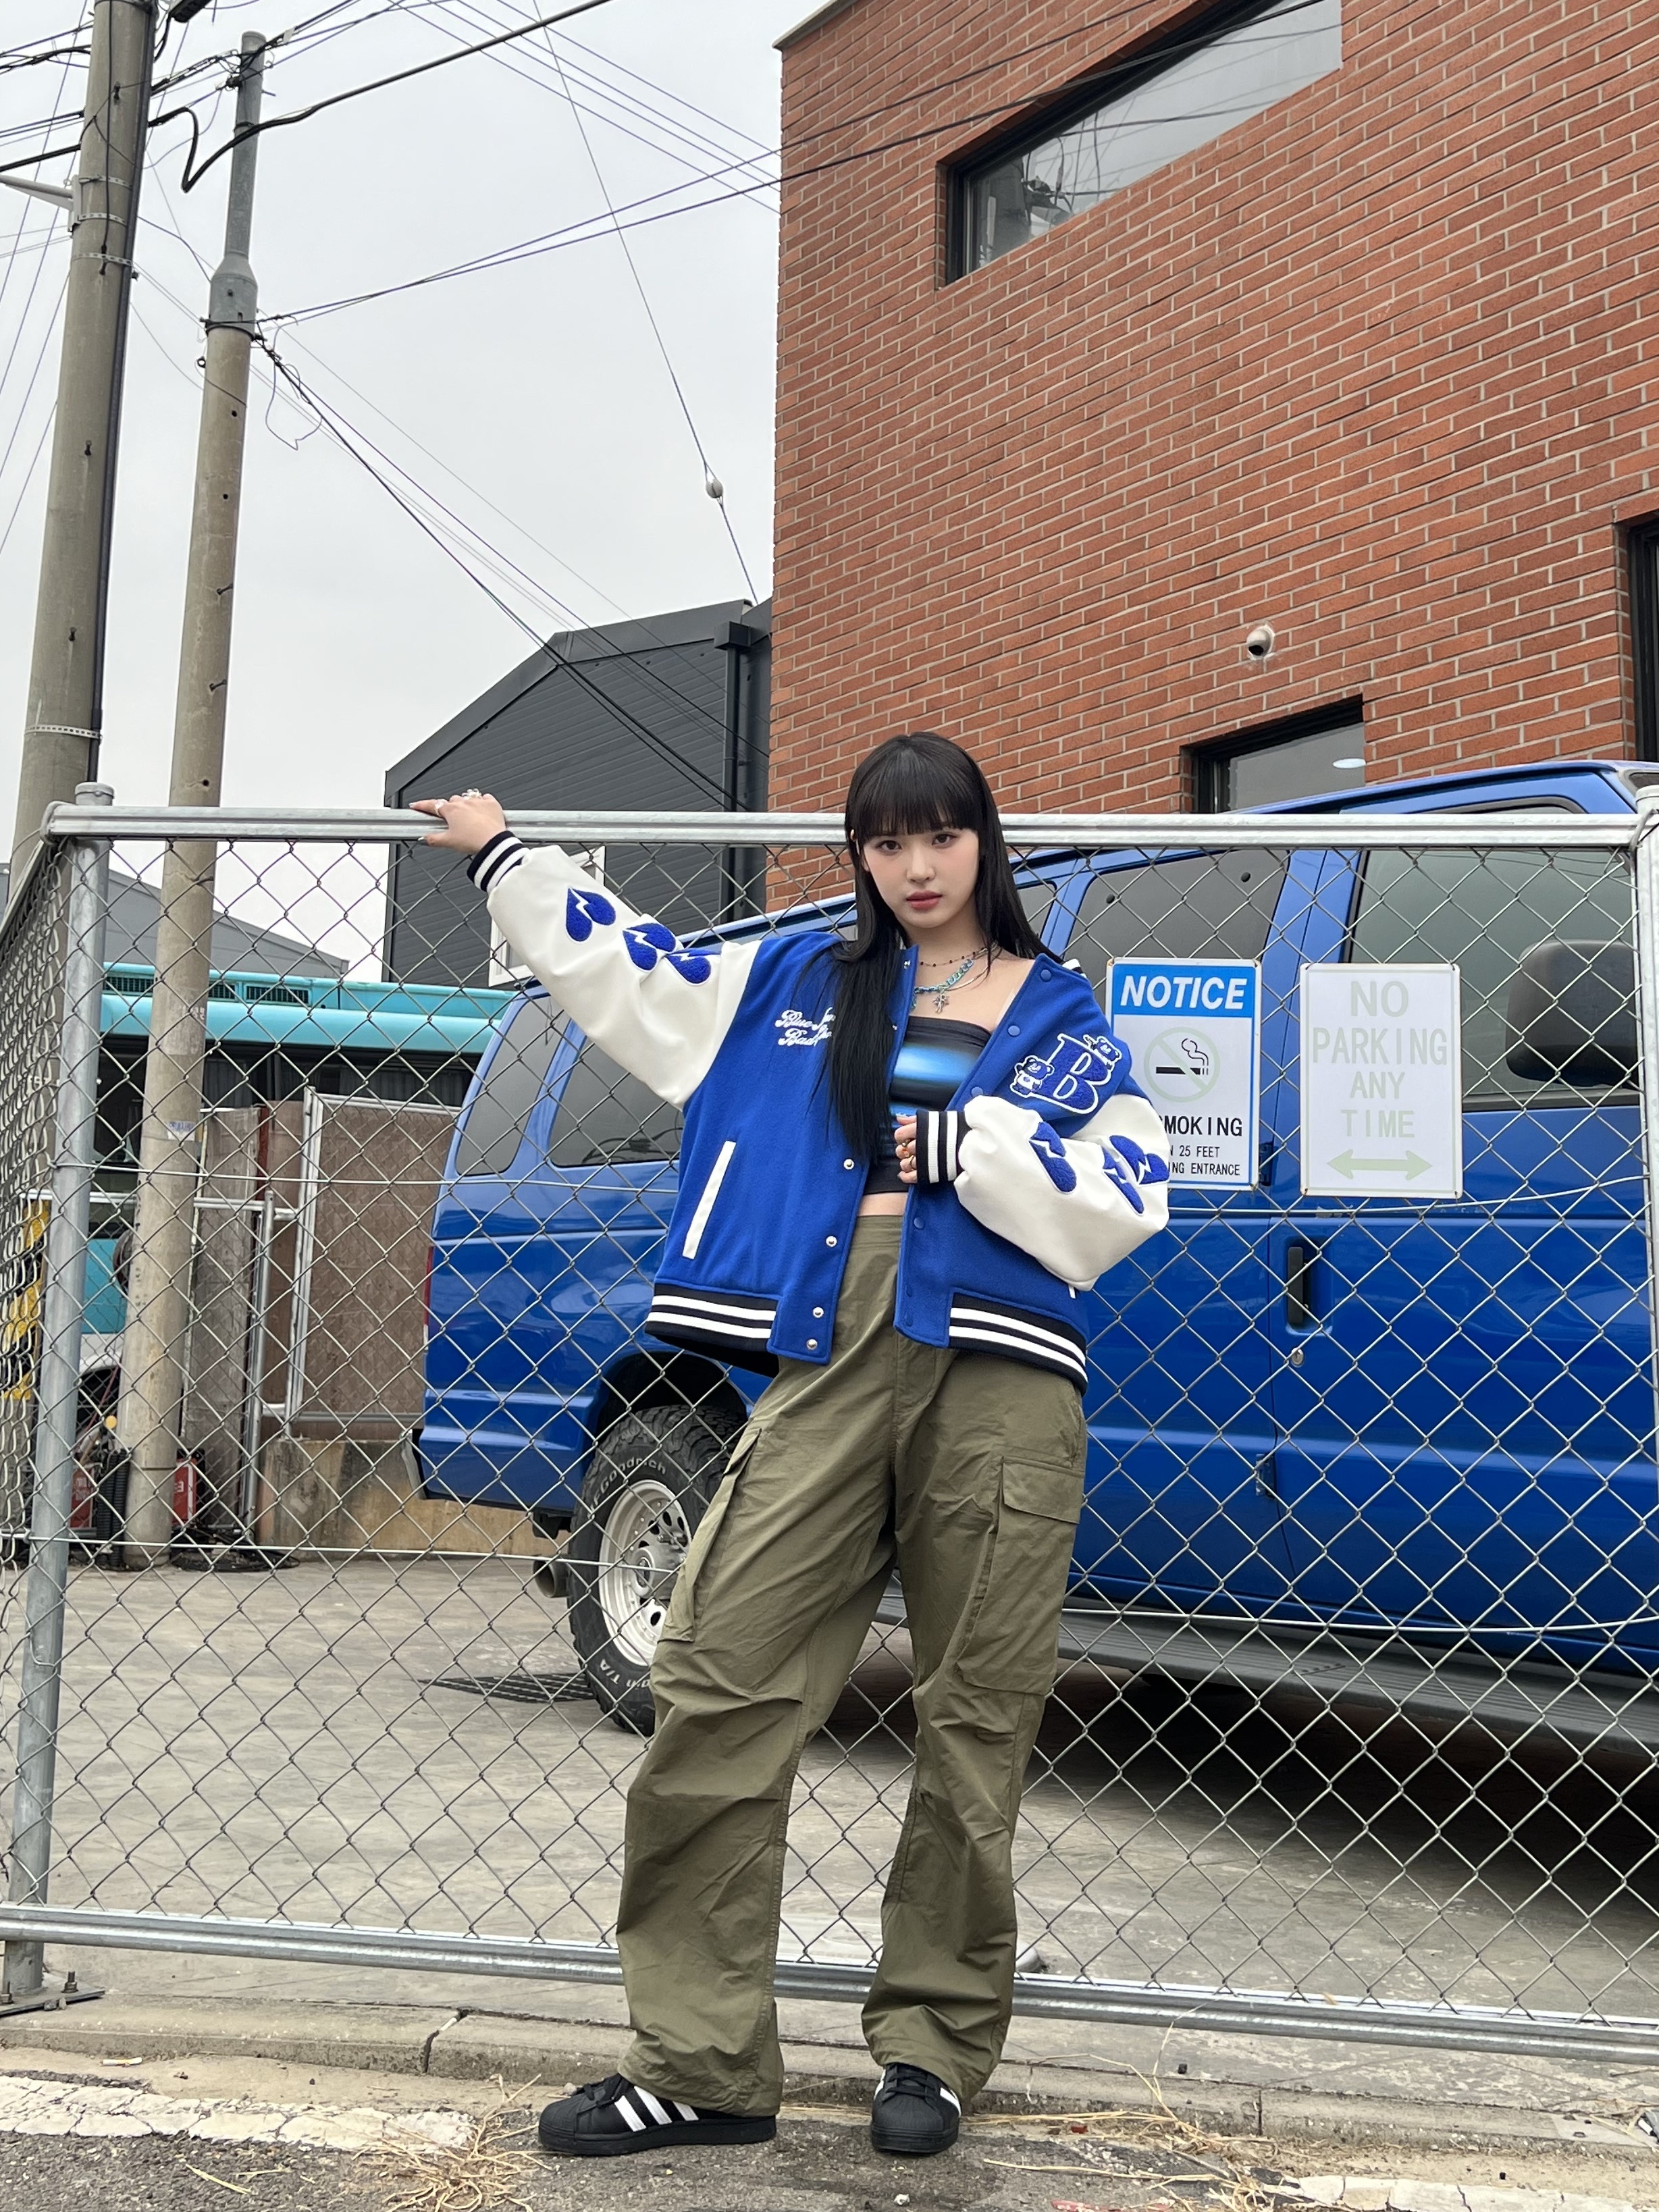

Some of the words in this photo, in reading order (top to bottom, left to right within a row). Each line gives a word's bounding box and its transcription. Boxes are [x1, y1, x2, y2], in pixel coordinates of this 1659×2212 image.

[1120, 976, 1247, 1009] NOTICE
[1350, 980, 1409, 1018] NO
[1313, 1026, 1447, 1065] PARKING
[1350, 1071, 1406, 1099] ANY
[1159, 1115, 1242, 1136] MOKING
[1340, 1109, 1415, 1138] TIME
[1179, 1144, 1191, 1157] 25
[1196, 1145, 1220, 1158] FEET
[1190, 1162, 1240, 1176] ENTRANCE
